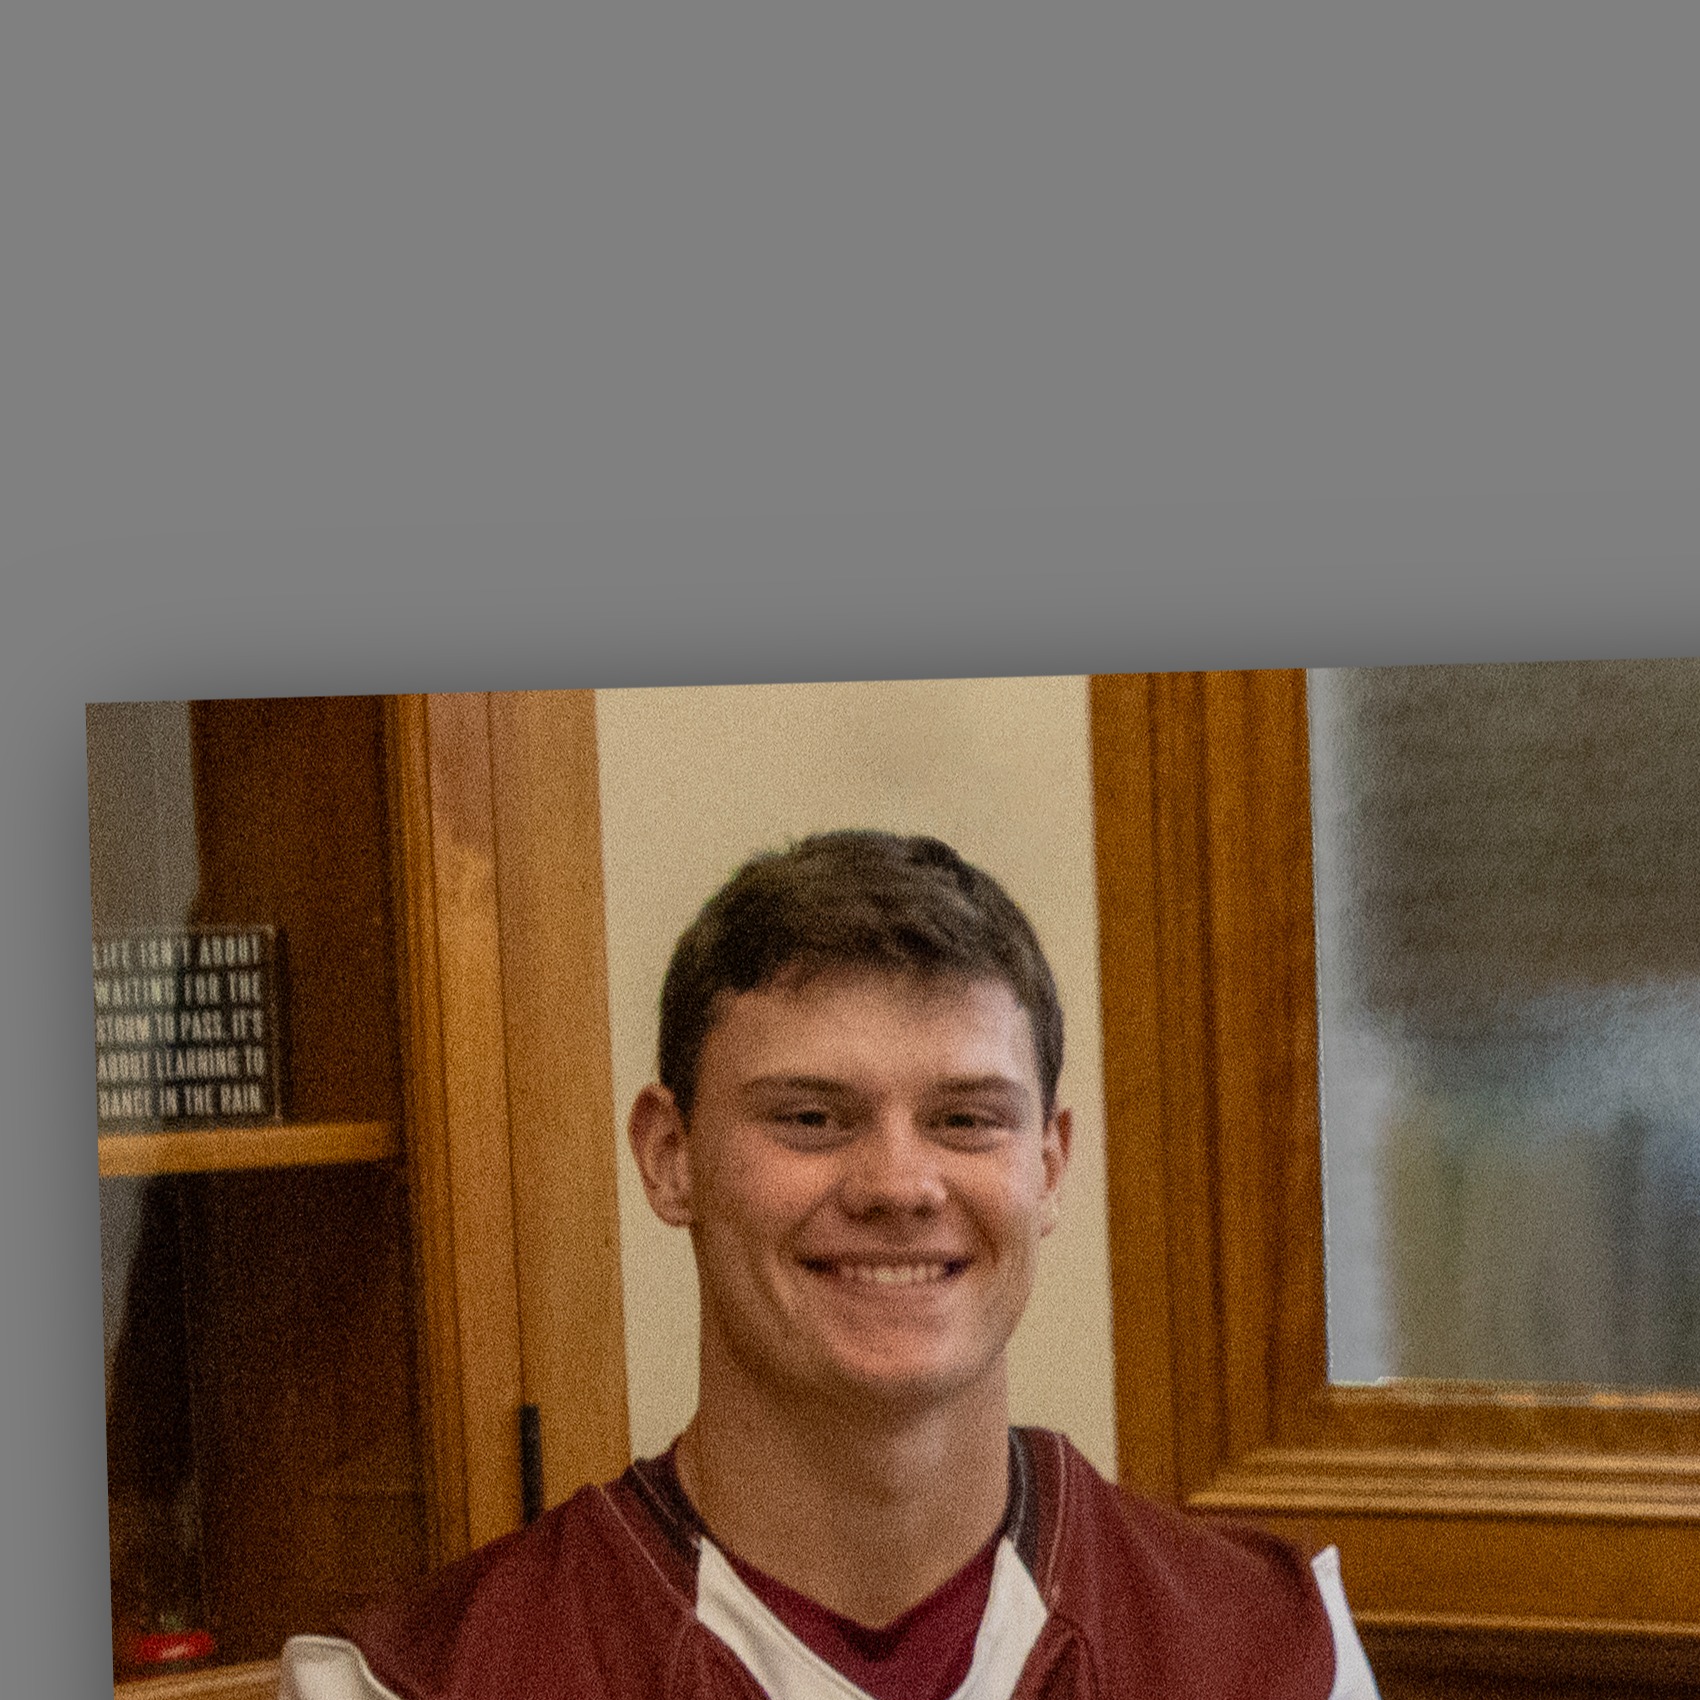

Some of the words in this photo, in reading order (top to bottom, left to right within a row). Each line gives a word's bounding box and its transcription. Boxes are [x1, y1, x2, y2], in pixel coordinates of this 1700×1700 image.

[201, 932, 261, 968] ABOUT
[95, 976, 175, 1006] WAITING
[183, 973, 221, 1005] FOR
[229, 971, 262, 1003] THE
[96, 1012, 150, 1043] STORM
[153, 1011, 175, 1041] TO
[98, 1050, 151, 1081] ABOUT
[154, 1047, 242, 1079] LEARNING
[245, 1045, 266, 1077] TO
[100, 1087, 152, 1117] DANCE
[159, 1086, 178, 1116] IN
[184, 1084, 216, 1115] THE
